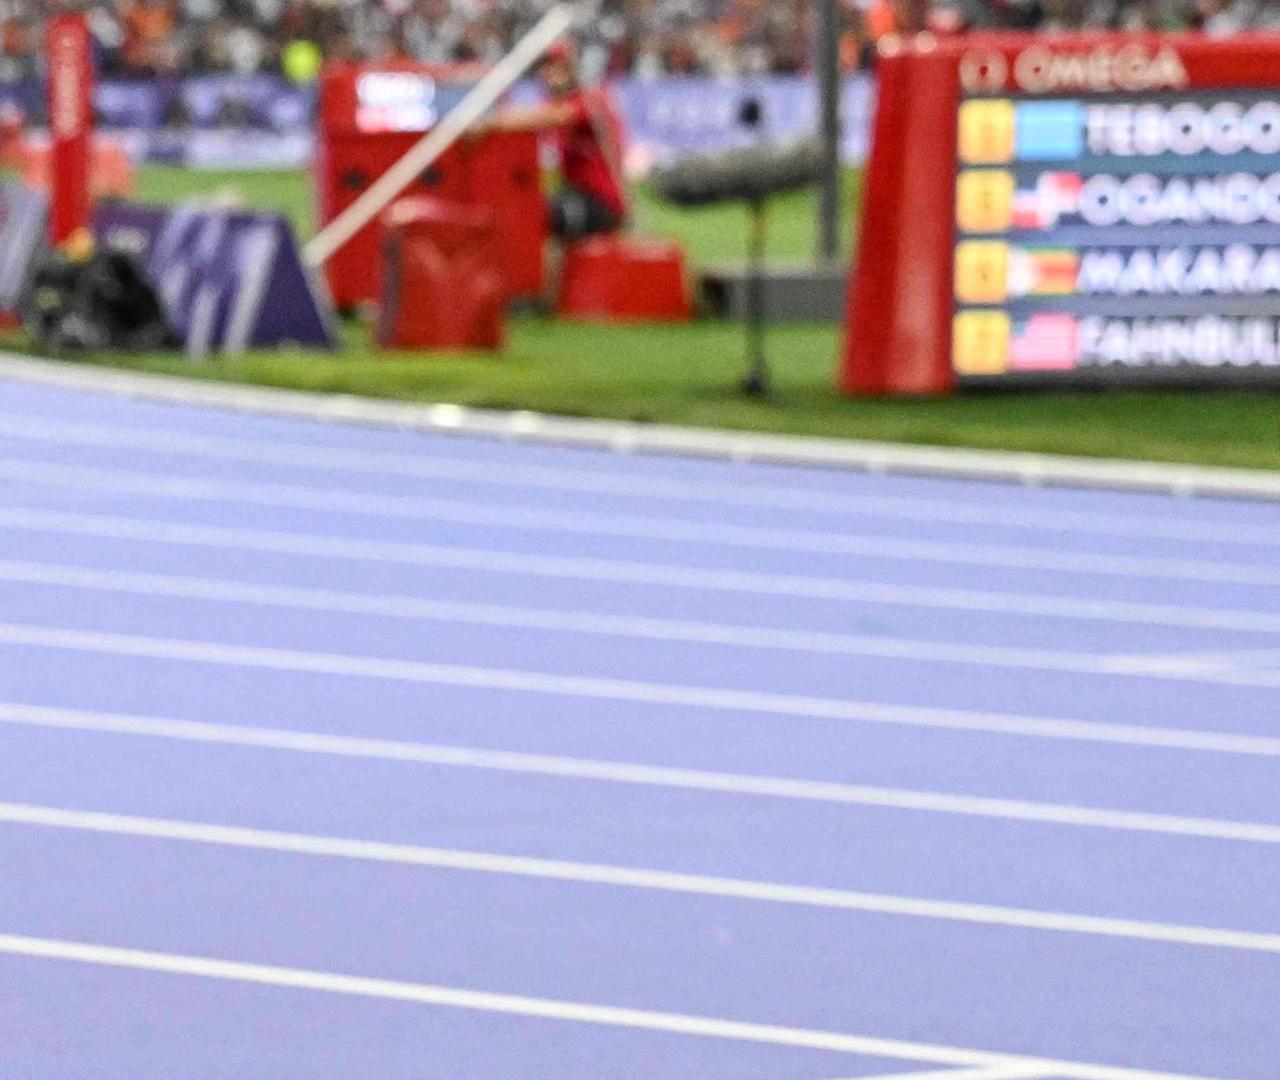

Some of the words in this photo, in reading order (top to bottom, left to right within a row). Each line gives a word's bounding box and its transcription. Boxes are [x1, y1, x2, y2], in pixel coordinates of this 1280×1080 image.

[1015, 45, 1188, 92] OMEGA
[1086, 103, 1280, 155] TEBOGO
[1079, 247, 1280, 295] MAKARA
